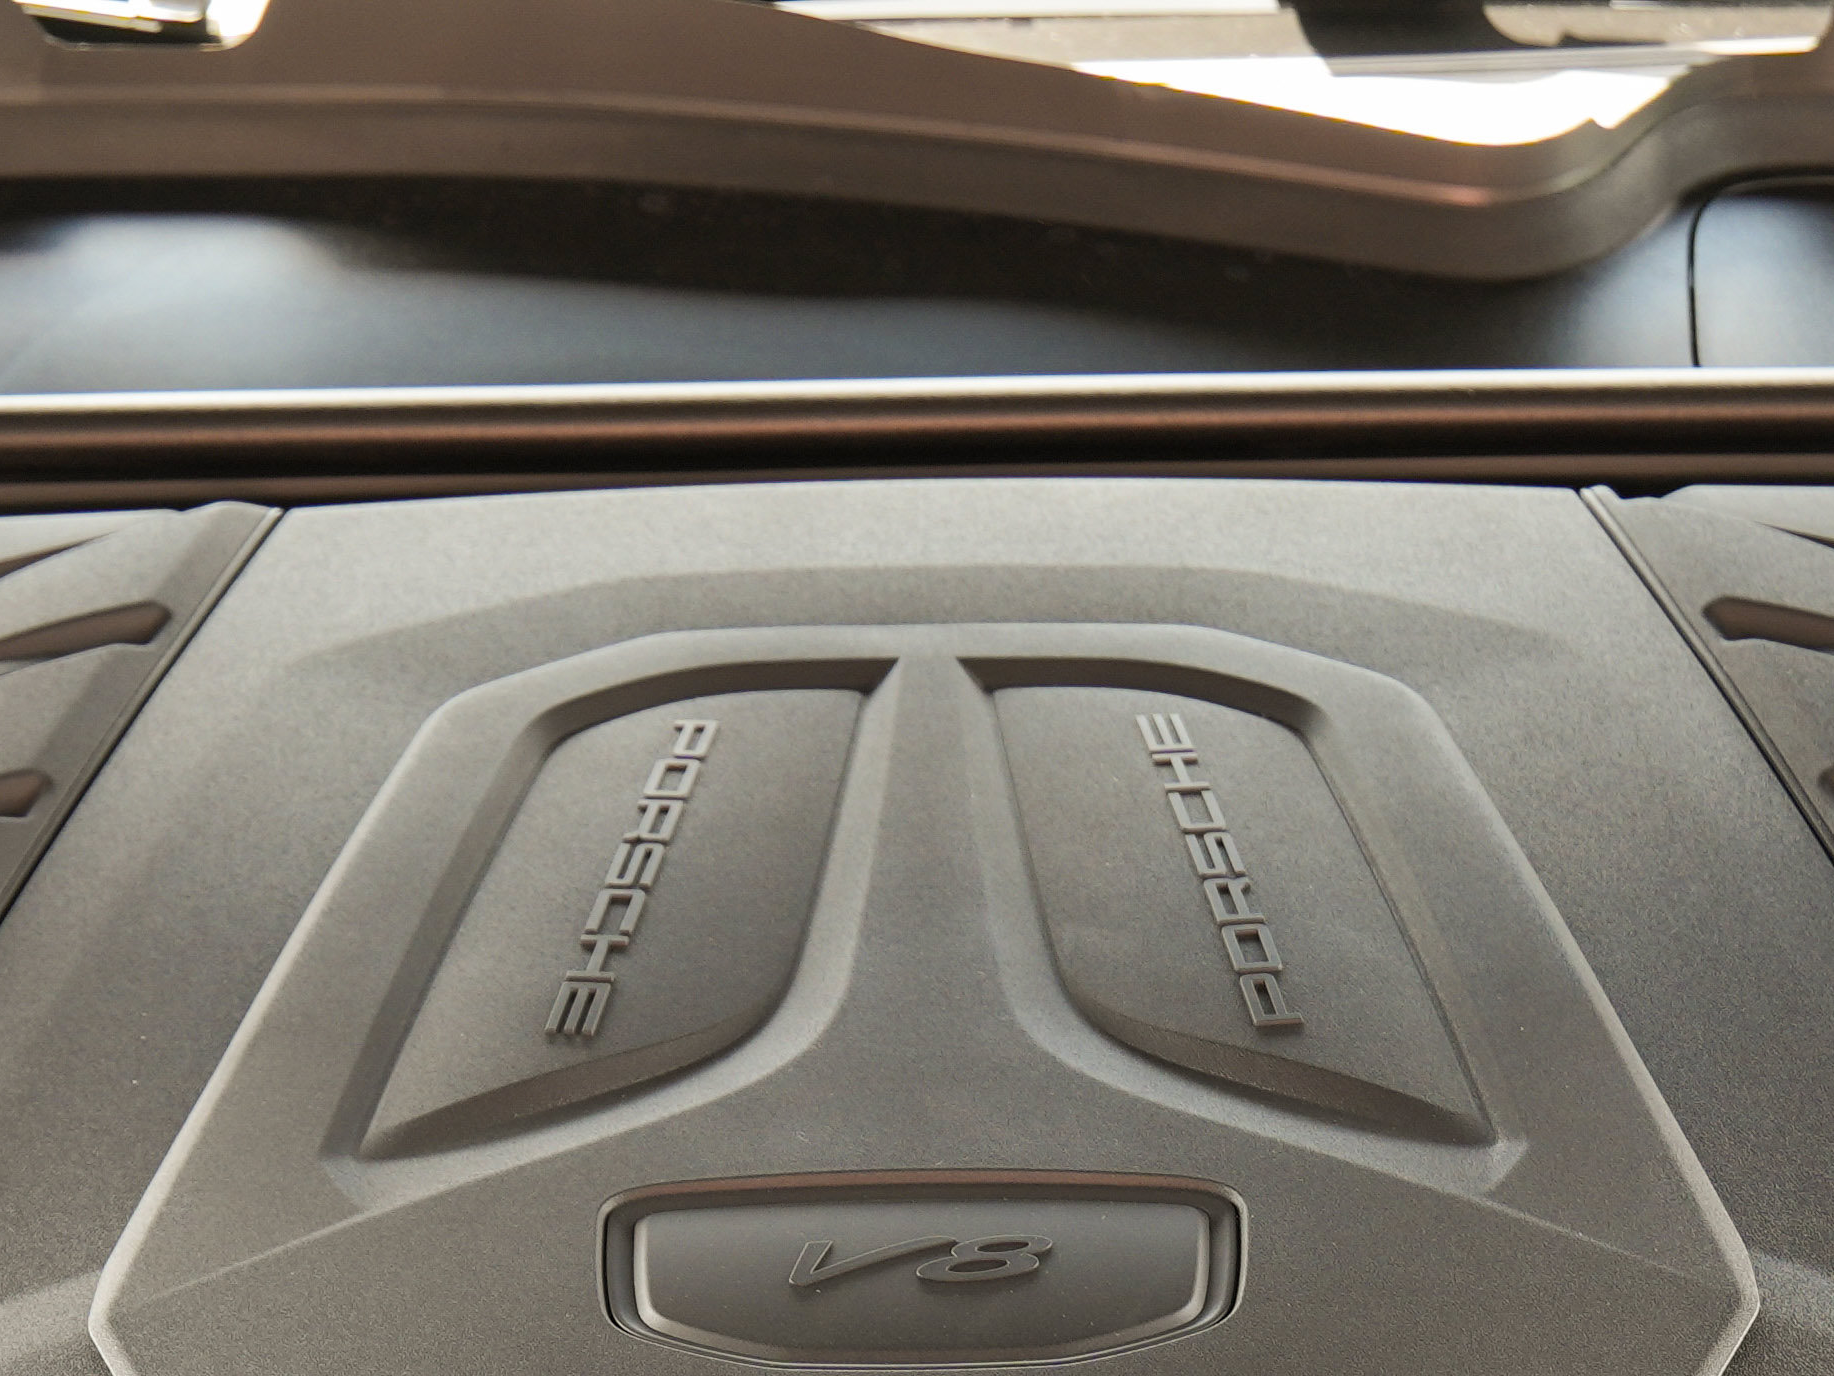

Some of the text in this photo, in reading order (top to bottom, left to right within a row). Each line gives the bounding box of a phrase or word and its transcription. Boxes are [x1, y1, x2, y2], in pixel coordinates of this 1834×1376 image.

[544, 719, 718, 1039] PORSCHE
[1136, 712, 1305, 1031] PORSCHE
[787, 1233, 1054, 1287] V8
